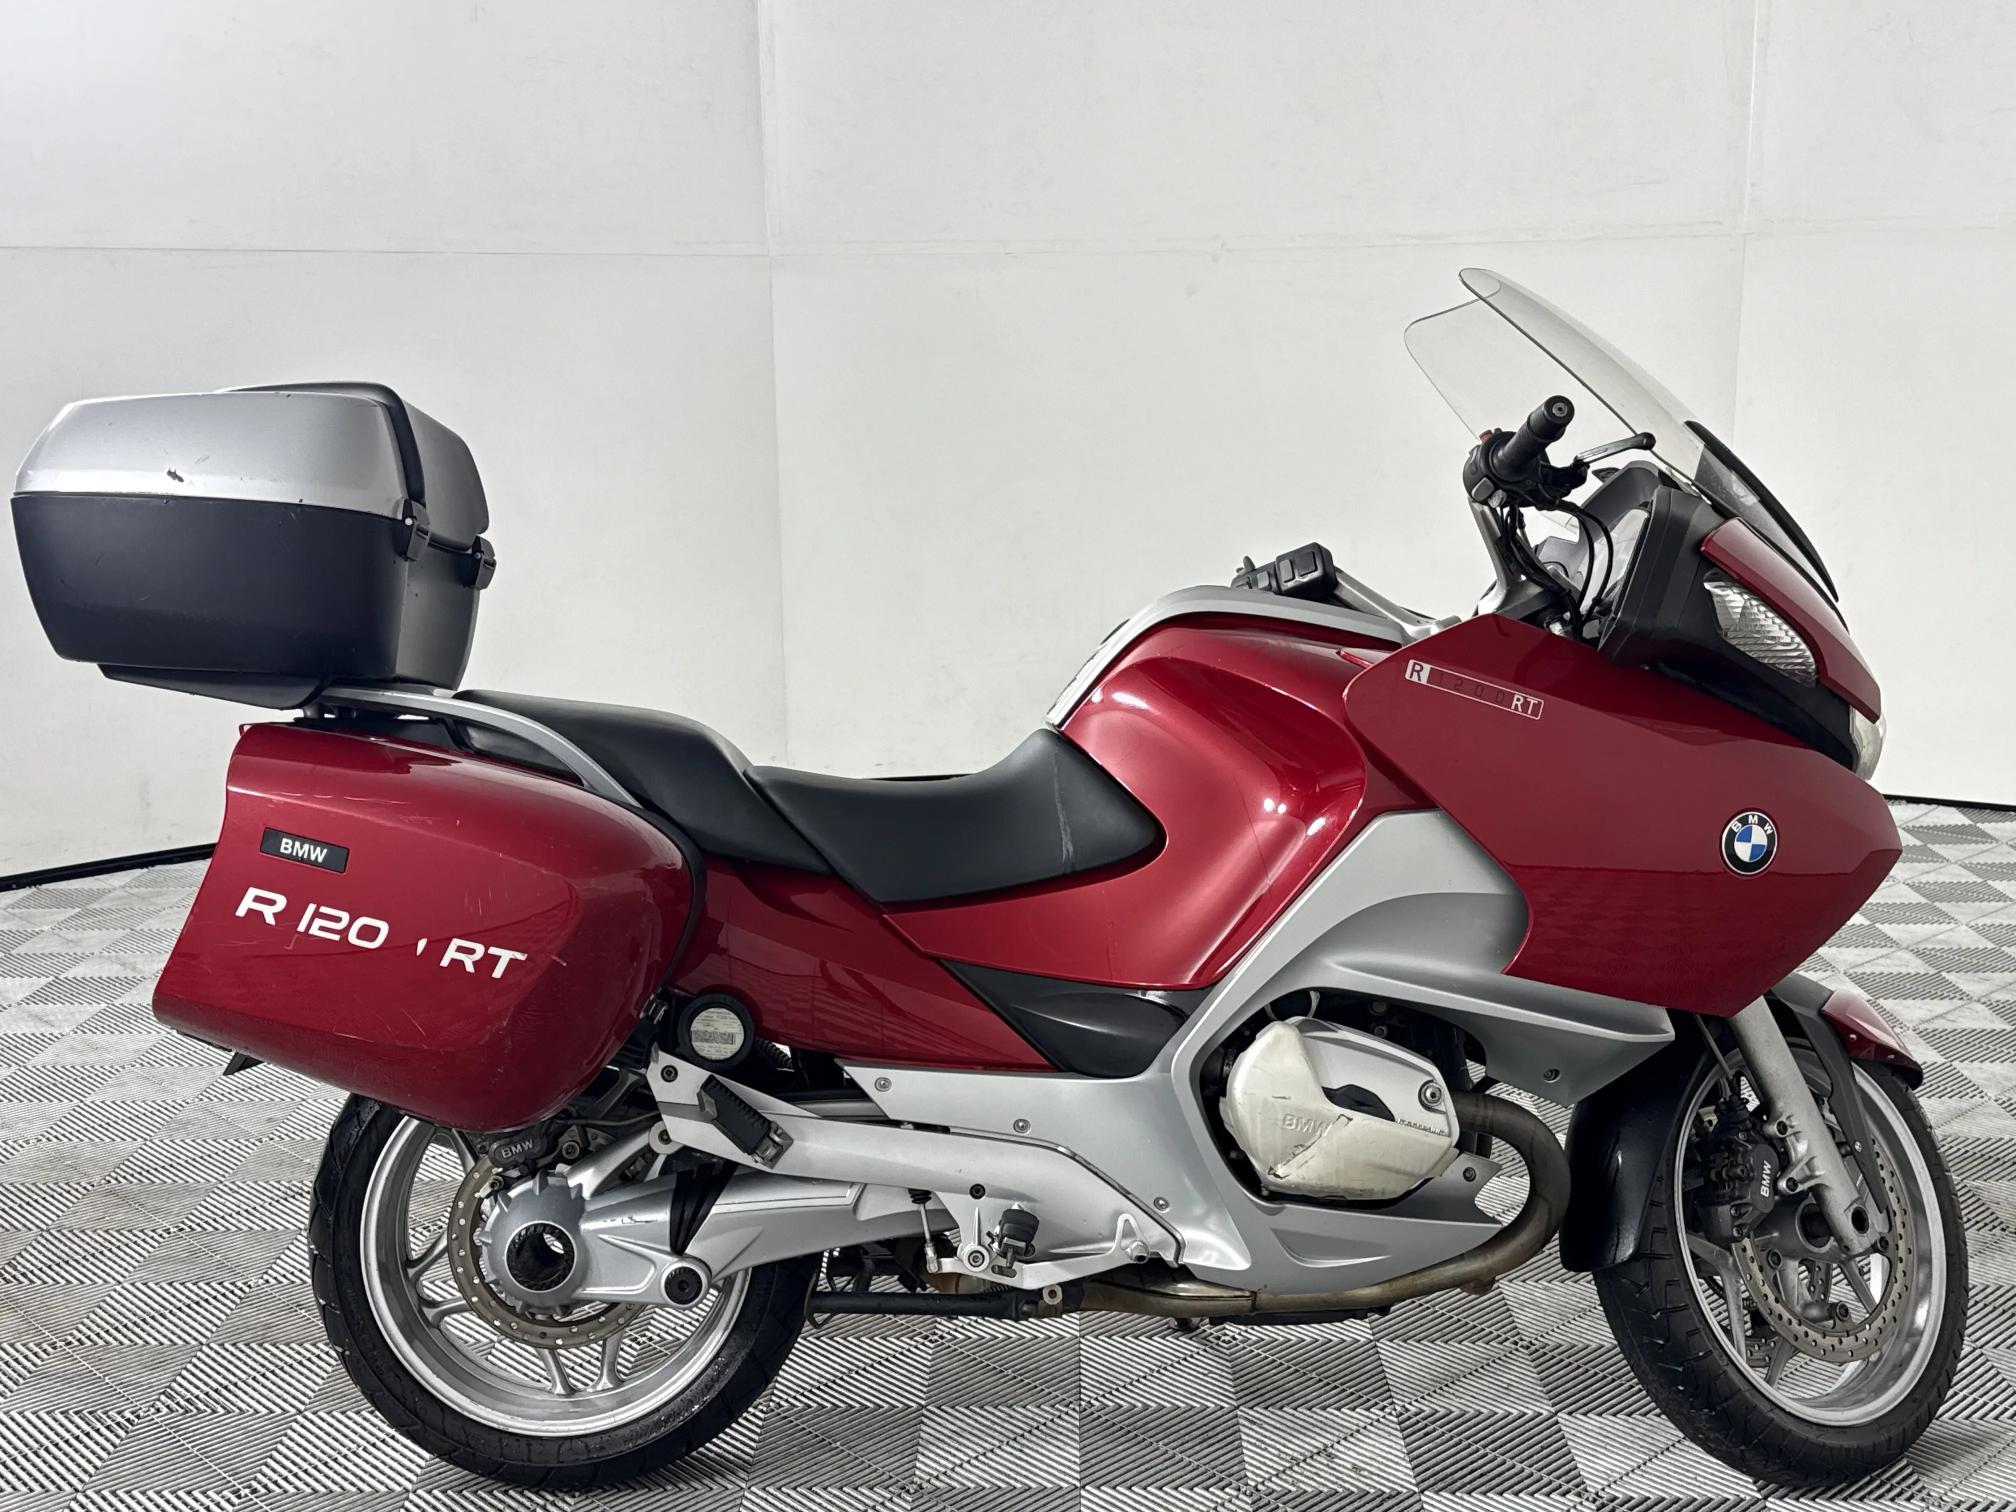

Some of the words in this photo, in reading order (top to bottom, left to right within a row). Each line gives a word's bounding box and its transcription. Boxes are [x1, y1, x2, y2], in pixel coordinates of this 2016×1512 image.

[1409, 662, 1424, 681] R
[1511, 694, 1538, 714] RT
[1731, 814, 1774, 835] BMW
[280, 838, 328, 863] BMW
[235, 887, 287, 926] R
[440, 938, 528, 979] RT
[1282, 1113, 1332, 1137] BMW
[501, 1140, 533, 1158] BMW
[1760, 1160, 1771, 1198] BMW
